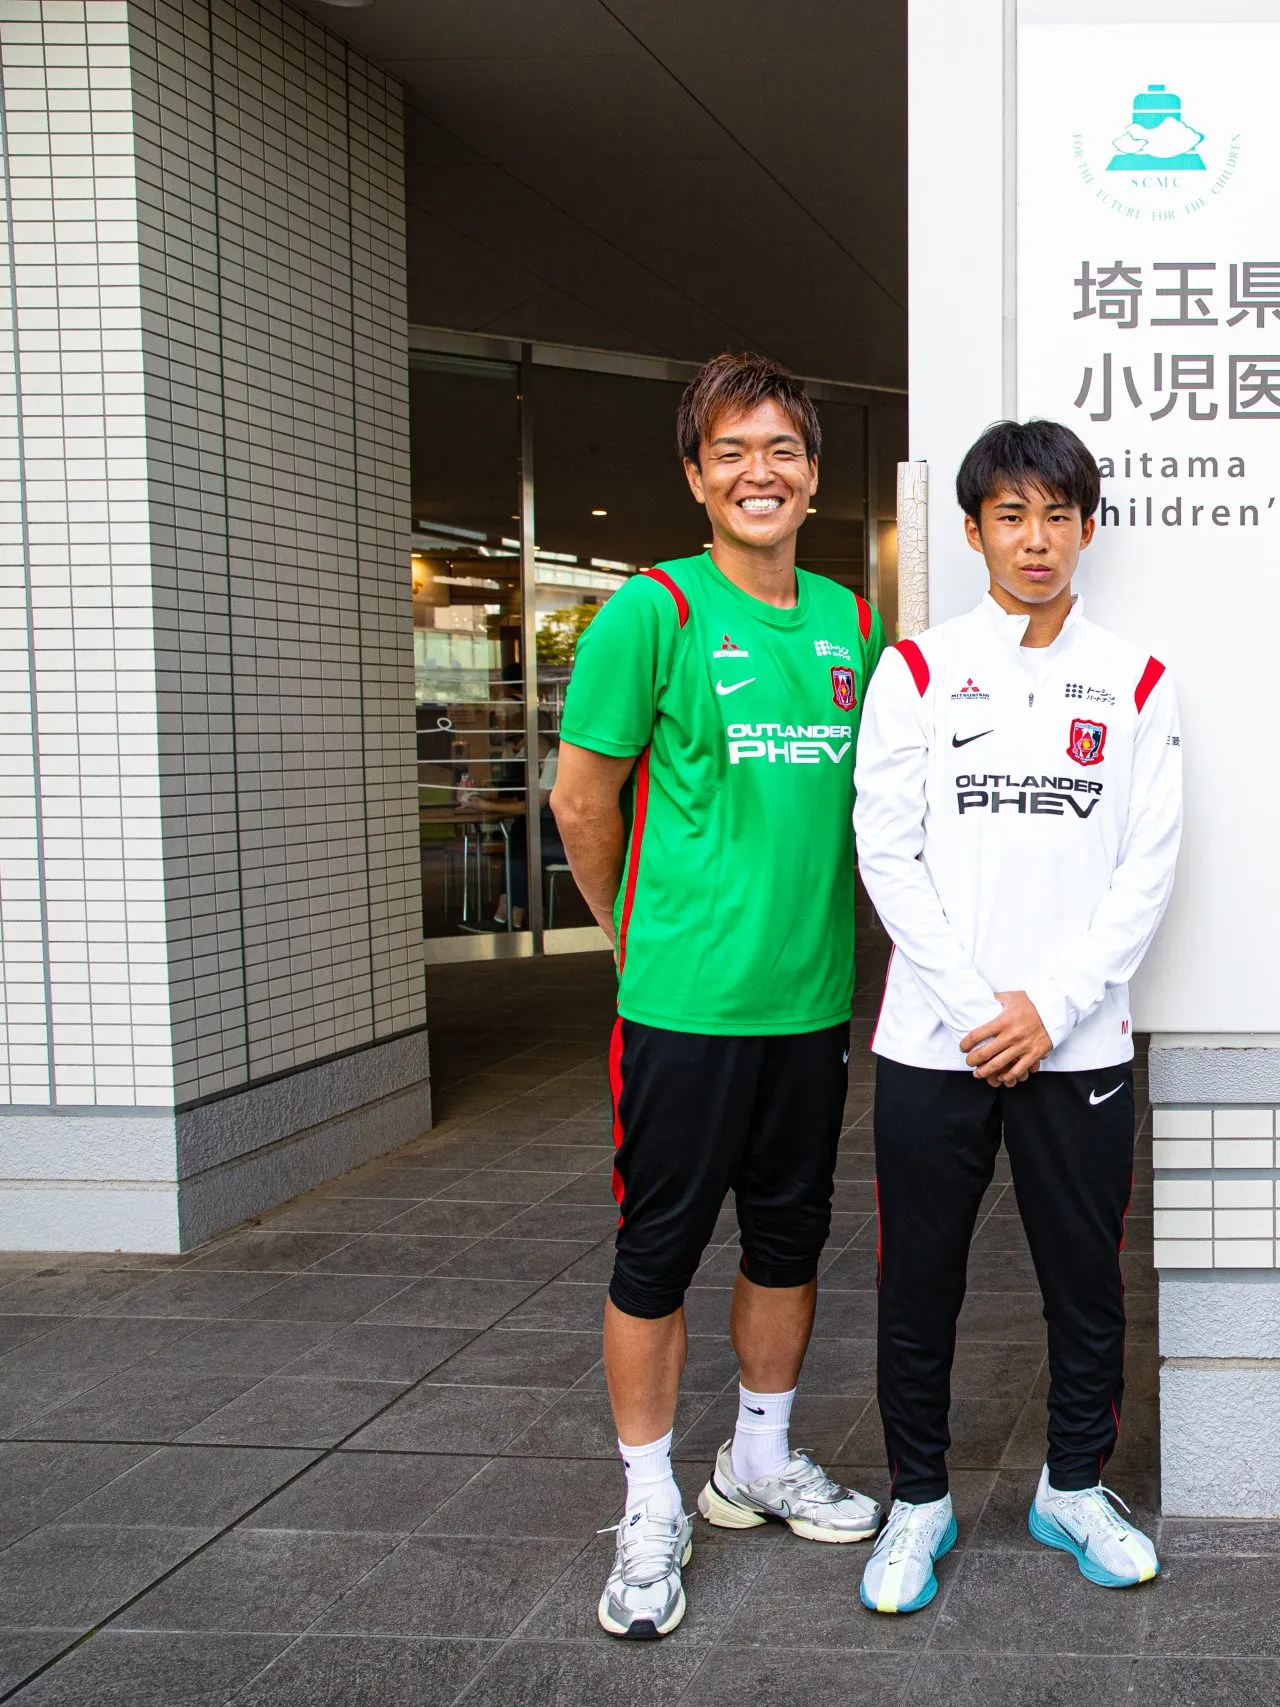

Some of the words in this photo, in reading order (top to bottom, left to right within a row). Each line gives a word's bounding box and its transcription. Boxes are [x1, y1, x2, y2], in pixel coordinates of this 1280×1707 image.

[1072, 134, 1084, 158] FOR
[1078, 162, 1094, 184] THE
[1096, 189, 1143, 220] FUTURE
[1152, 211, 1176, 221] FOR
[1184, 197, 1208, 215] THE
[1211, 133, 1241, 195] CHILDREN
[1098, 450, 1245, 478] aitama
[727, 723, 852, 739] OUTLANDER
[728, 740, 852, 765] PHEV
[956, 774, 1104, 795] OUTLANDER
[957, 791, 1101, 819] PHEV
